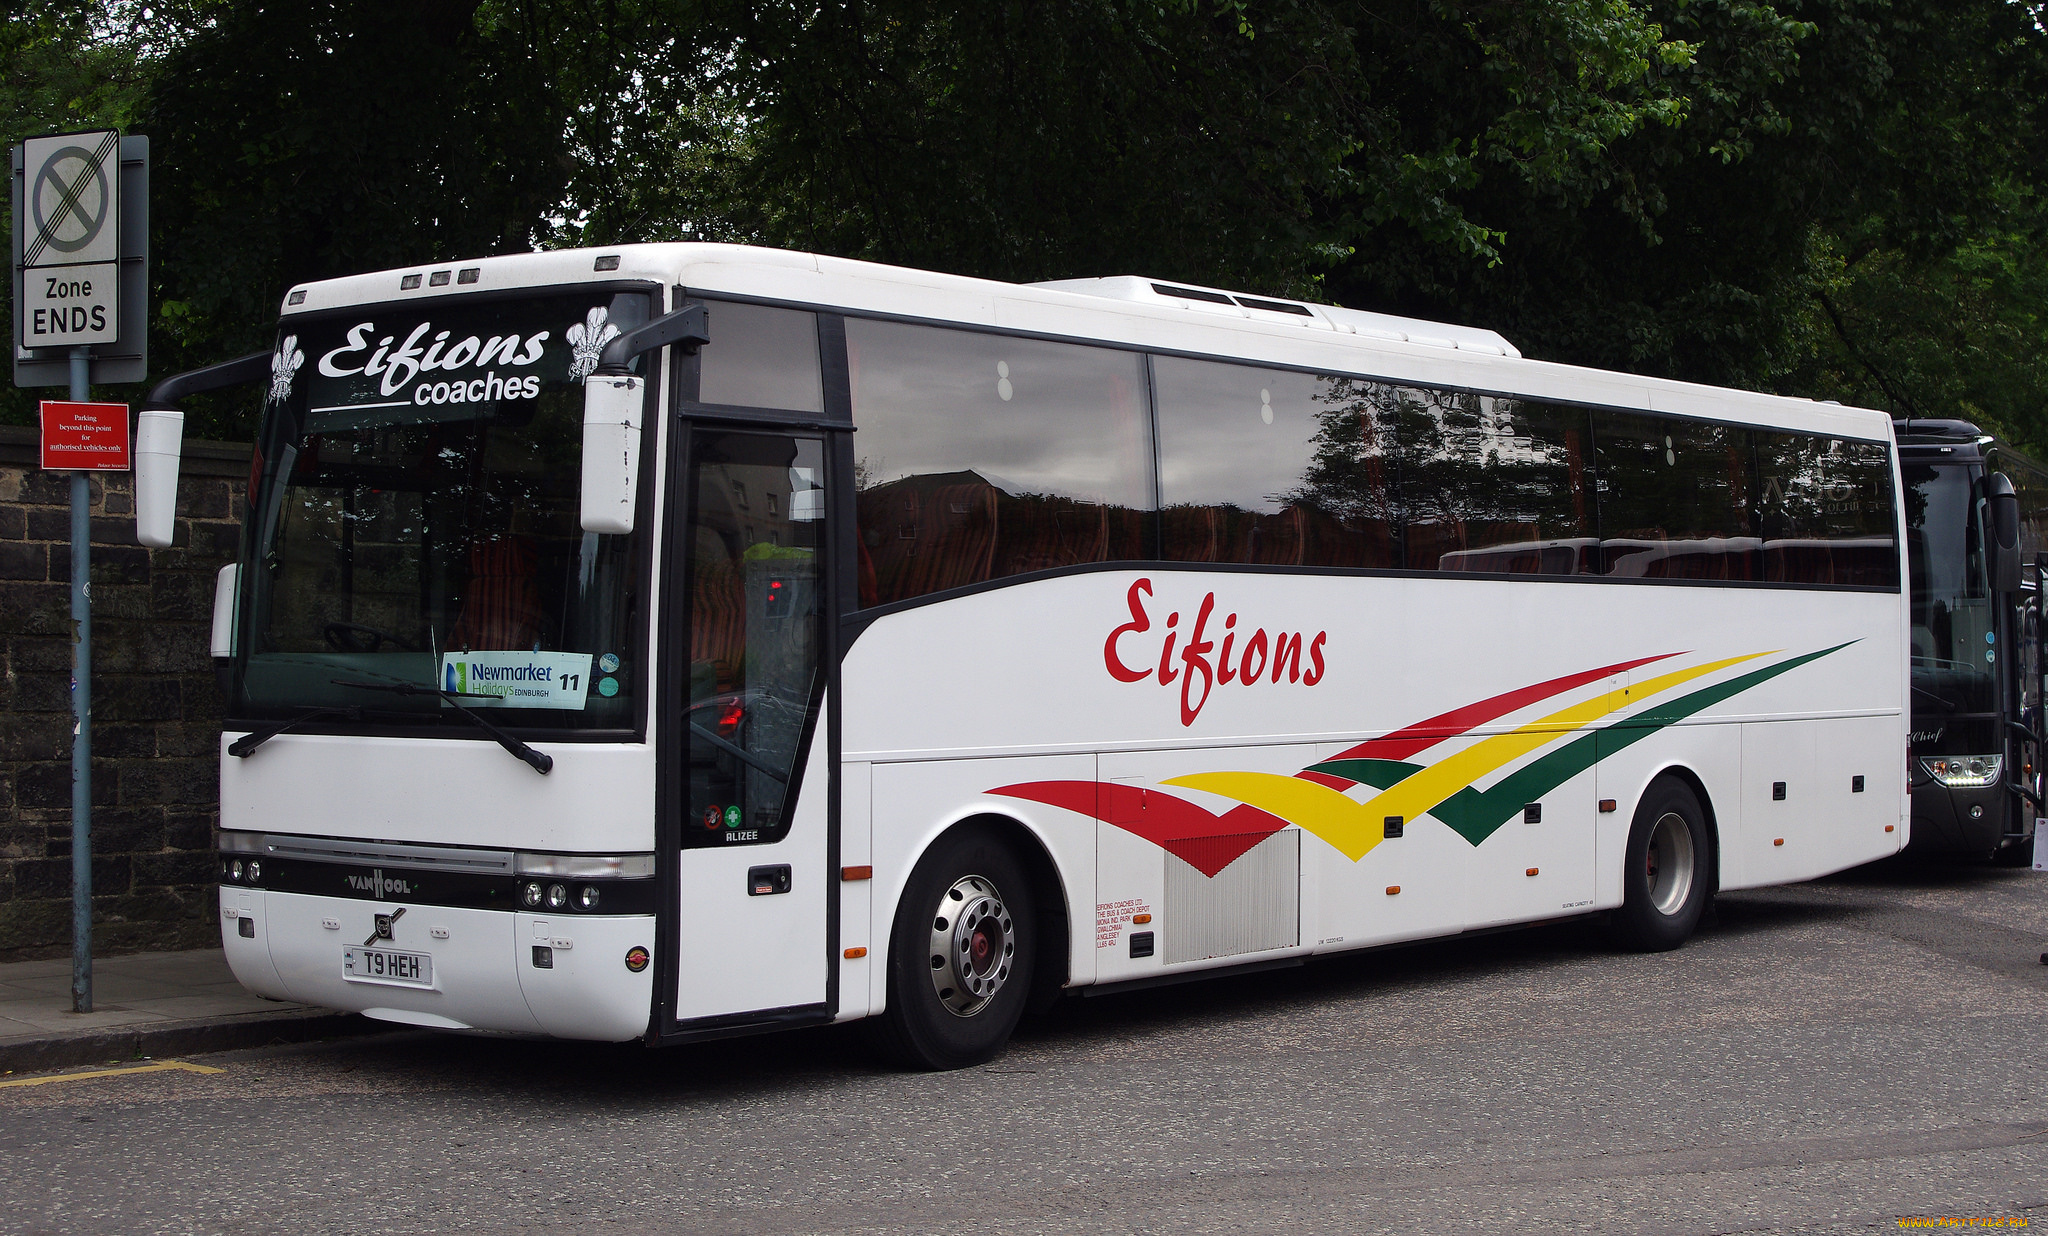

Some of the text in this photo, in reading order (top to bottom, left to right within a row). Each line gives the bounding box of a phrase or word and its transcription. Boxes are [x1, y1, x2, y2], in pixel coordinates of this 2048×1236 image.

[46, 278, 92, 298] Zone
[33, 305, 106, 334] ENDS
[318, 321, 550, 396] Eifions
[414, 371, 540, 406] coaches
[74, 414, 97, 422] Parking
[59, 424, 82, 432] beyond
[49, 443, 82, 451] authorised
[1104, 578, 1326, 727] Eifions
[472, 663, 552, 682] Newmarket
[472, 683, 549, 697] Holidays EDINBURGH
[559, 674, 579, 691] 11
[726, 831, 758, 841] ALIZEE
[1114, 900, 1134, 909] COACHES
[1136, 905, 1150, 913] DEPOT
[1097, 932, 1119, 940] ANGLESEY
[364, 951, 419, 978] T9 HEH
